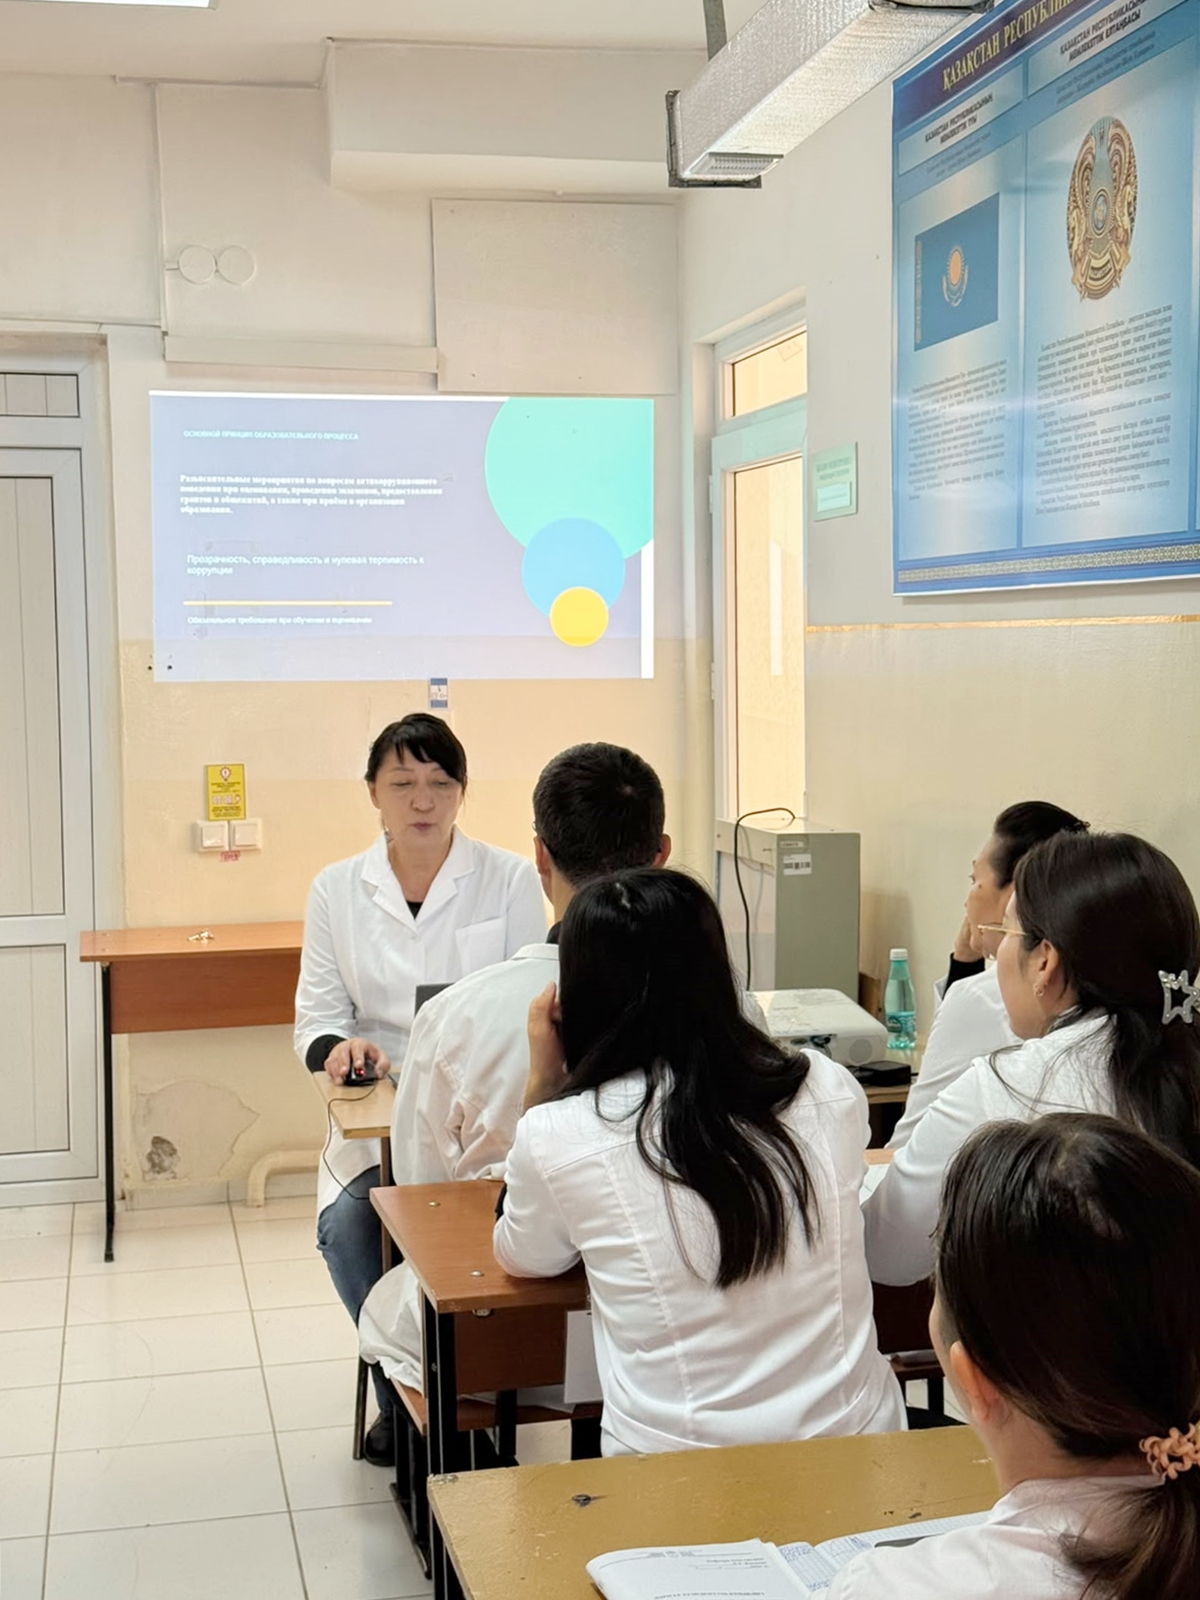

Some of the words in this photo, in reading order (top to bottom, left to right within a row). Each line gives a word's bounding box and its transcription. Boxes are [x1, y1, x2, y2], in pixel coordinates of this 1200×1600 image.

[943, 31, 1000, 91] ҚАЗАҚСТАН
[183, 430, 220, 438] ОСНОВНОЙ
[221, 430, 253, 439] ПРИНЦИП
[254, 431, 323, 440] ОБРАЗОВАТЕЛЬНОГО
[323, 432, 359, 441] ПРОЦЕССА
[302, 498, 317, 506] при
[187, 554, 251, 565] Прозрачность,
[252, 556, 322, 566] справедливость
[331, 557, 367, 567] нулевая
[368, 557, 418, 566] терпимость
[187, 567, 234, 576] коррупции
[238, 616, 277, 625] требование
[279, 617, 291, 625] при
